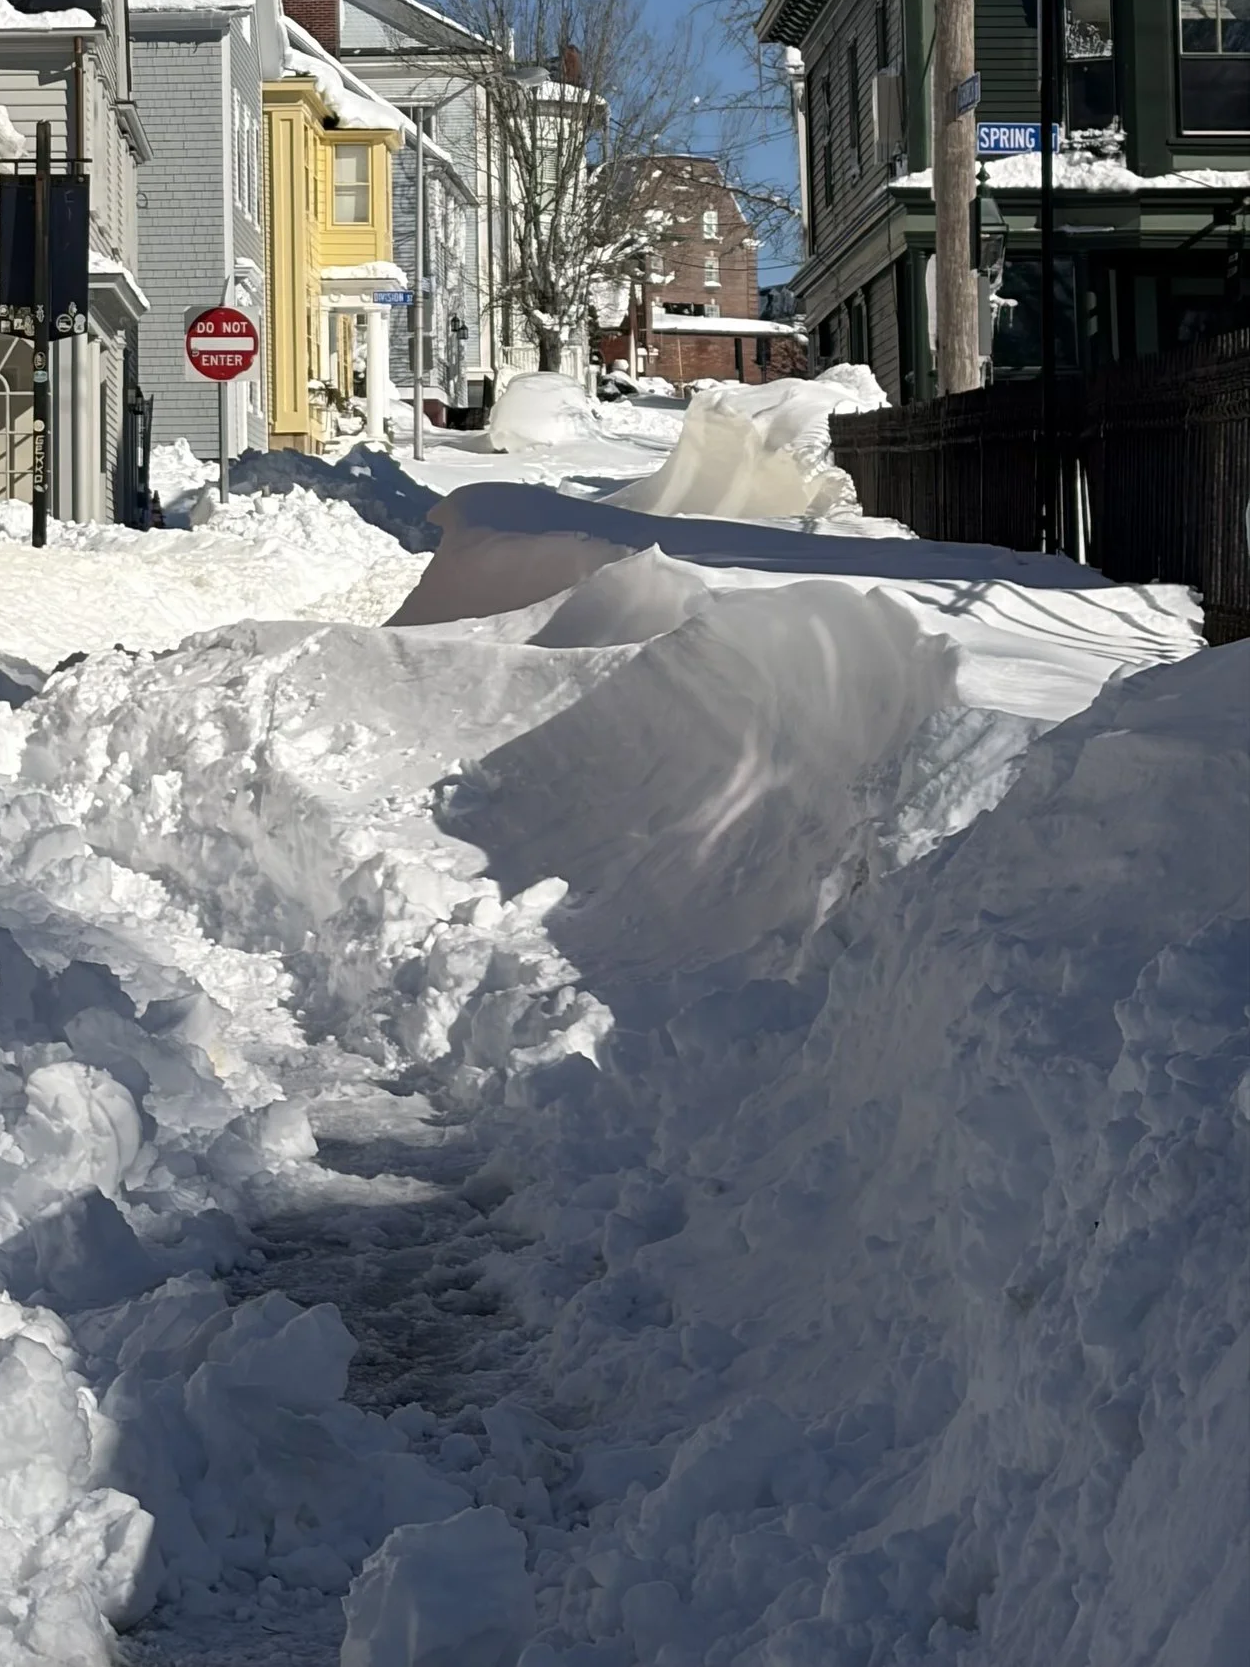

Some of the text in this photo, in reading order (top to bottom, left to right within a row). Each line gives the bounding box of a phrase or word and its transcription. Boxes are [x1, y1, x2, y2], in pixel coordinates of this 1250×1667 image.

[980, 127, 1035, 149] SPRING
[374, 292, 404, 302] DIVISION
[197, 321, 248, 334] DO NOT
[201, 354, 243, 366] ENTER
